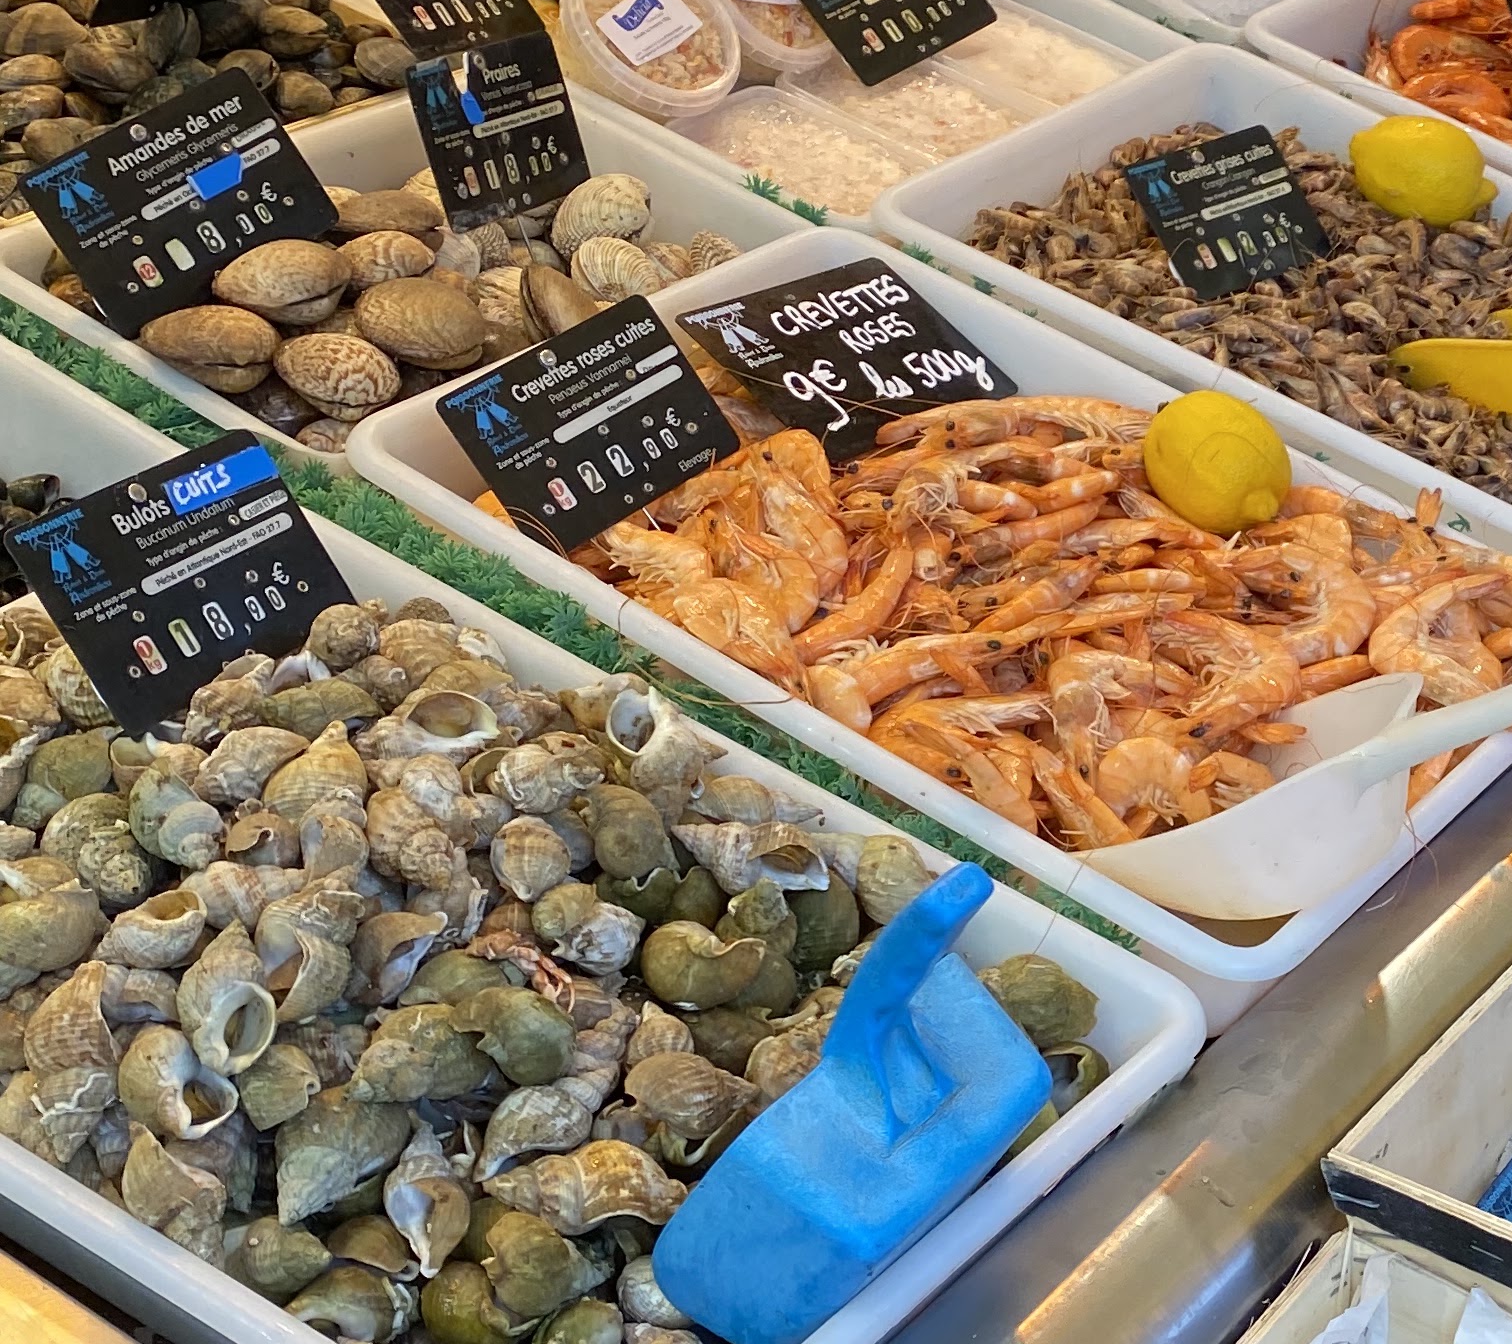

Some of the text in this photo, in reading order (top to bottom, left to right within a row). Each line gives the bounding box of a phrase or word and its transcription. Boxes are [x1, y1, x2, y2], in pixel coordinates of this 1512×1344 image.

[482, 61, 522, 86] Praires
[105, 94, 244, 177] Amandes de mer
[134, 120, 239, 184] Glycemeris Glycemeris
[770, 274, 910, 337] CREVETTES
[839, 311, 916, 355] ROSES
[509, 313, 656, 404] Crevettes roses cuites
[547, 376, 588, 404] Penaeus
[782, 359, 850, 433] 9€
[902, 349, 994, 394] 500g
[677, 446, 714, 473] Elevage
[14, 508, 84, 544] POISSONNERIE
[111, 492, 172, 538] Bulots
[135, 493, 235, 550] Buccinum Undatum
[154, 571, 178, 589] Pêché
[185, 549, 221, 573] Atlantique
